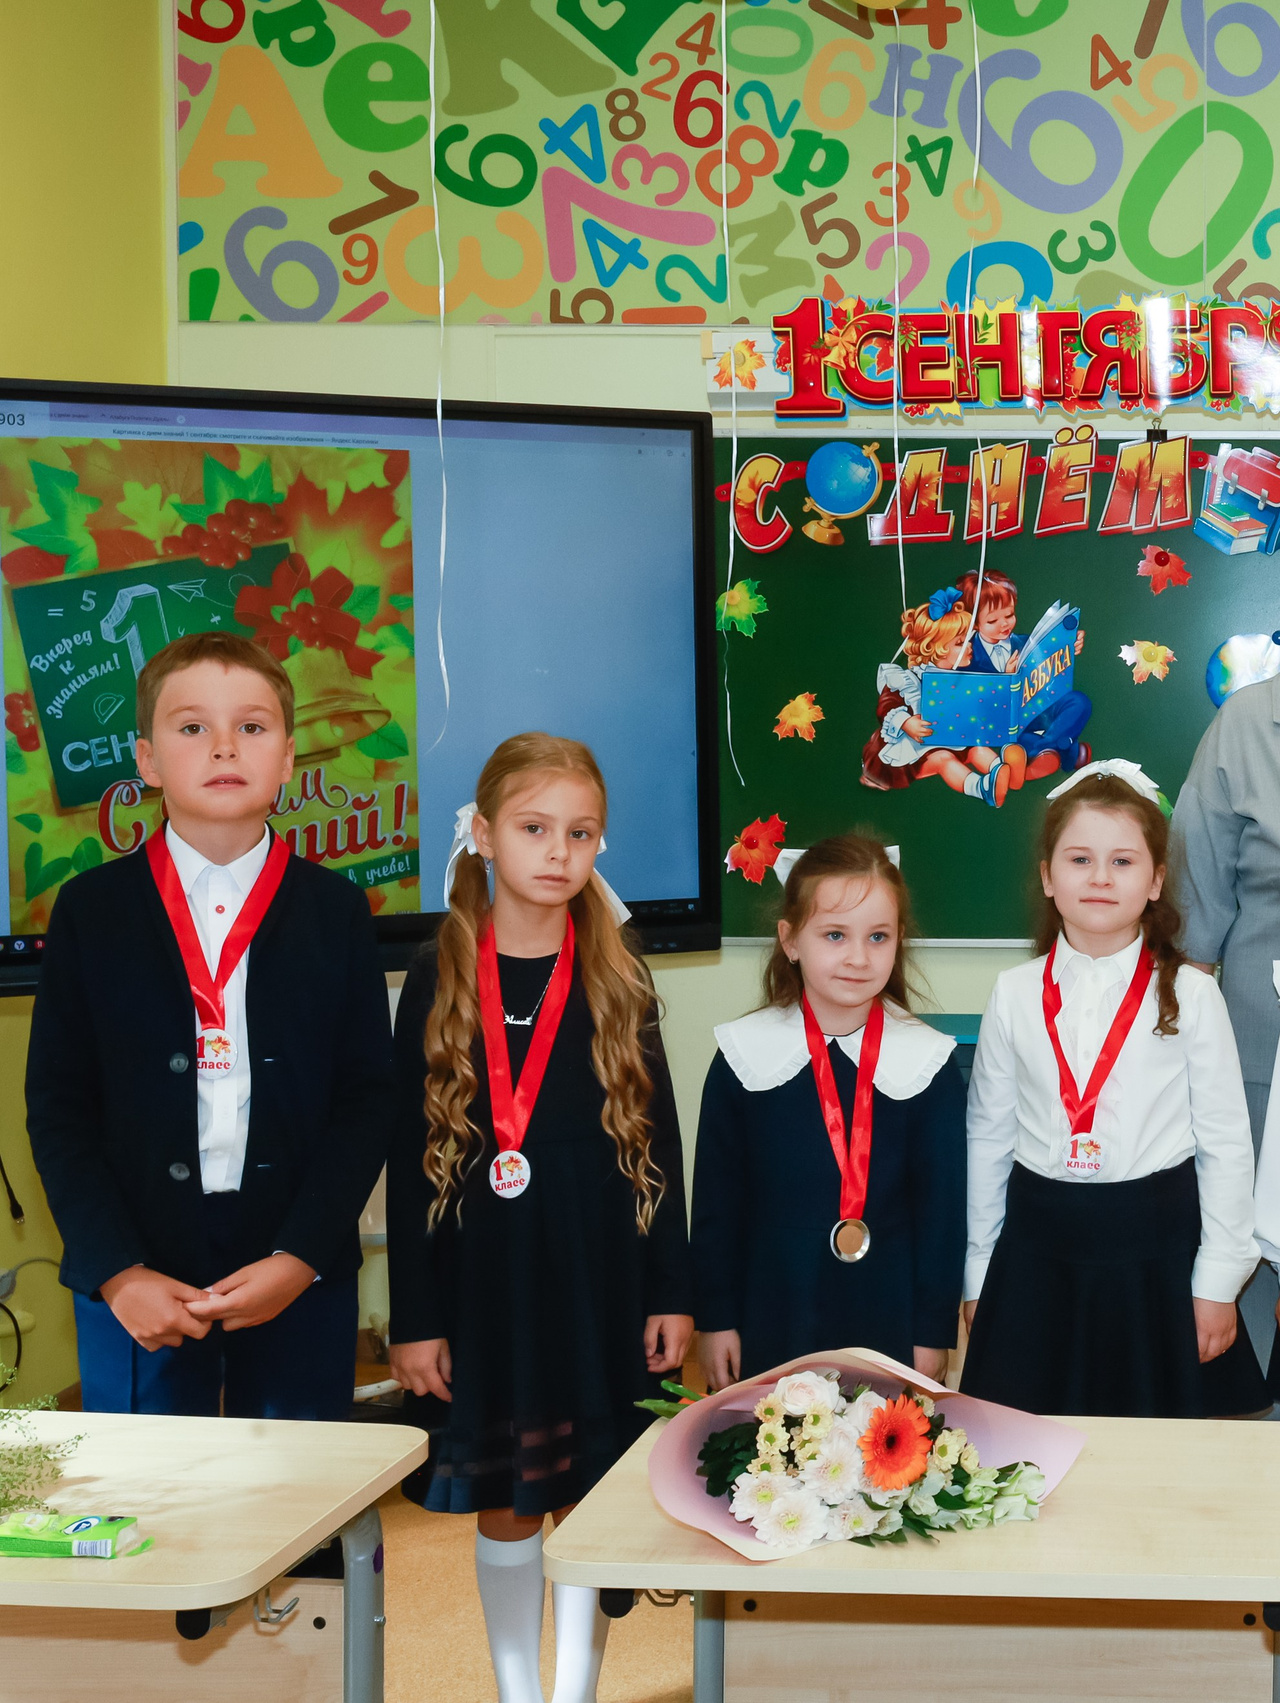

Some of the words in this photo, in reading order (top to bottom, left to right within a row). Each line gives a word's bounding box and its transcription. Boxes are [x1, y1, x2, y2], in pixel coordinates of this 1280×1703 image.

[675, 12, 716, 65] 4
[1090, 34, 1132, 91] 4
[323, 42, 433, 153] е
[641, 52, 680, 102] 2
[803, 38, 876, 131] 6
[869, 43, 964, 129] Н
[1111, 53, 1198, 133] 5
[177, 45, 343, 198] А
[605, 88, 646, 142] 8
[673, 70, 730, 148] 6
[735, 80, 800, 138] 2
[958, 49, 1124, 214] 6
[434, 124, 538, 207] 6
[539, 104, 606, 184] 4
[611, 144, 690, 206] 3
[695, 124, 779, 208] 8
[904, 135, 953, 197] 4
[864, 162, 911, 227] 3
[953, 178, 1001, 241] 9
[1118, 100, 1274, 286] 0
[342, 233, 378, 285] 9
[582, 218, 649, 288] 4
[800, 192, 861, 269] 5
[1047, 220, 1117, 275] 3
[223, 206, 340, 323] 6
[655, 254, 728, 303] 2
[773, 297, 847, 415] 1
[733, 452, 793, 553] С
[867, 424, 1193, 544] ДНЁМ
[80, 590, 97, 611] 5
[30, 630, 92, 673] Вперед
[1021, 644, 1071, 707] АЗБУКА
[46, 653, 121, 719] знаниям!
[366, 854, 411, 886] учебе!
[493, 1158, 504, 1181] 1
[1066, 1160, 1101, 1171] класс
[1070, 1138, 1080, 1160] 1
[494, 1176, 527, 1192] класс
